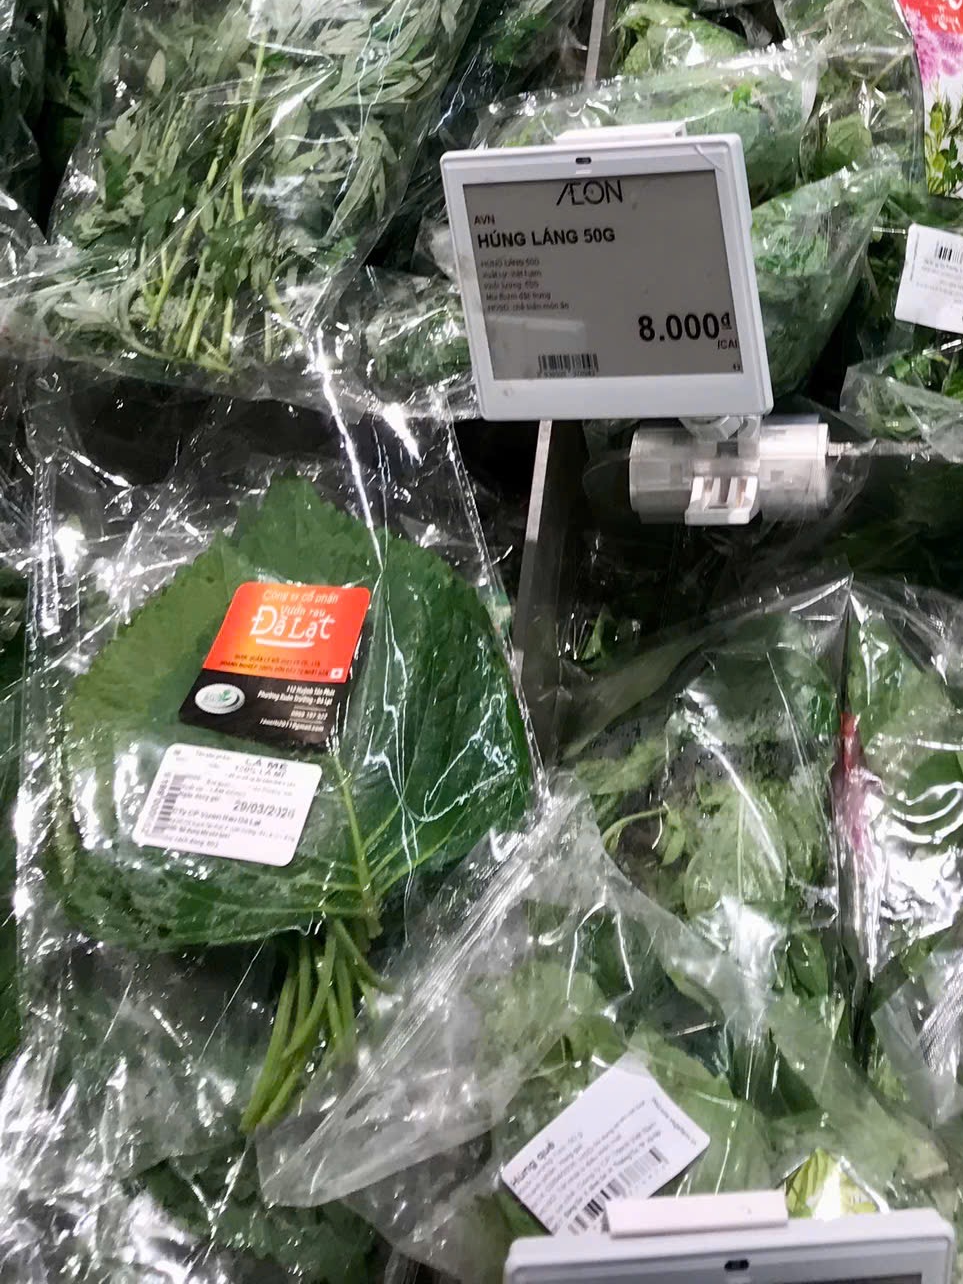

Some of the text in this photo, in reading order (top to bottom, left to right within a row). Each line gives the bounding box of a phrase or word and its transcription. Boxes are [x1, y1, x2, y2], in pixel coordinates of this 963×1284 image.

[474, 214, 495, 226] AVN
[478, 227, 616, 249] HÚNG LÁNG 50G
